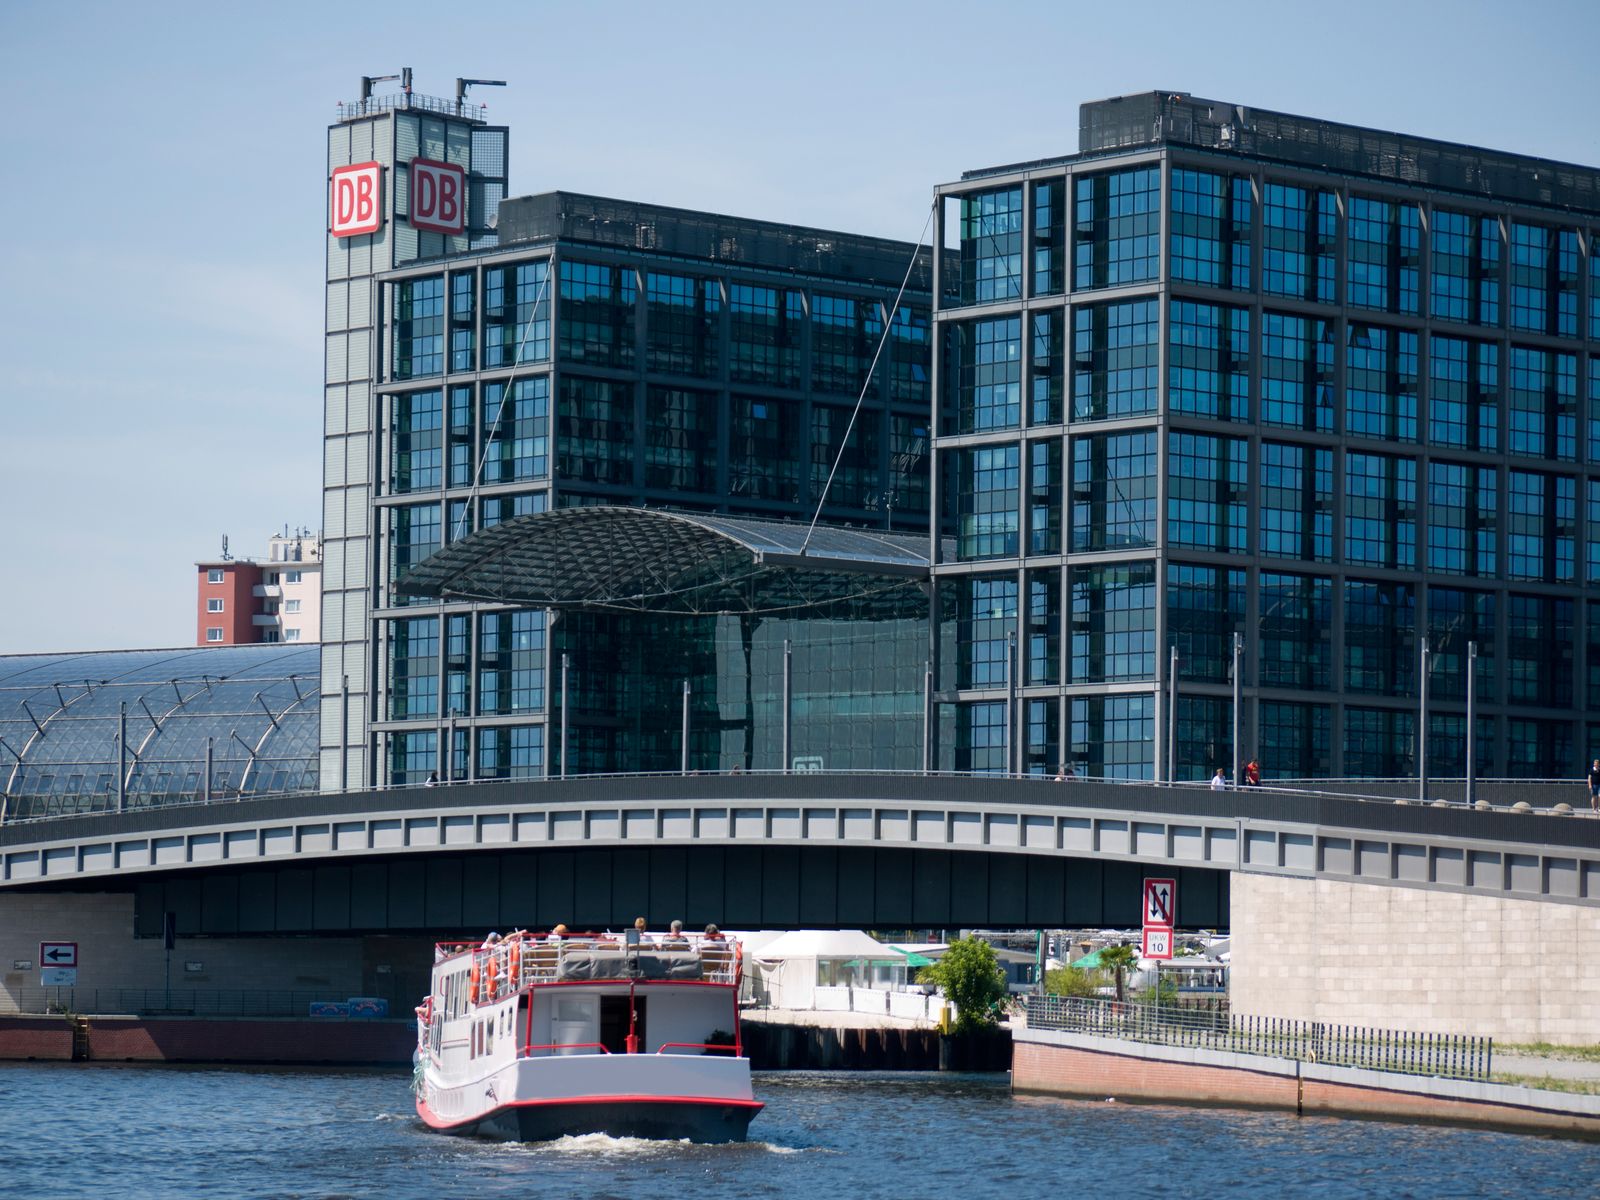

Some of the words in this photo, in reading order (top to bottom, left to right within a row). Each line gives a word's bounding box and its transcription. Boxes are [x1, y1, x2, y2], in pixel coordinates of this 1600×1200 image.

[337, 174, 373, 225] DB
[417, 169, 458, 222] DB
[1152, 943, 1164, 952] 10
